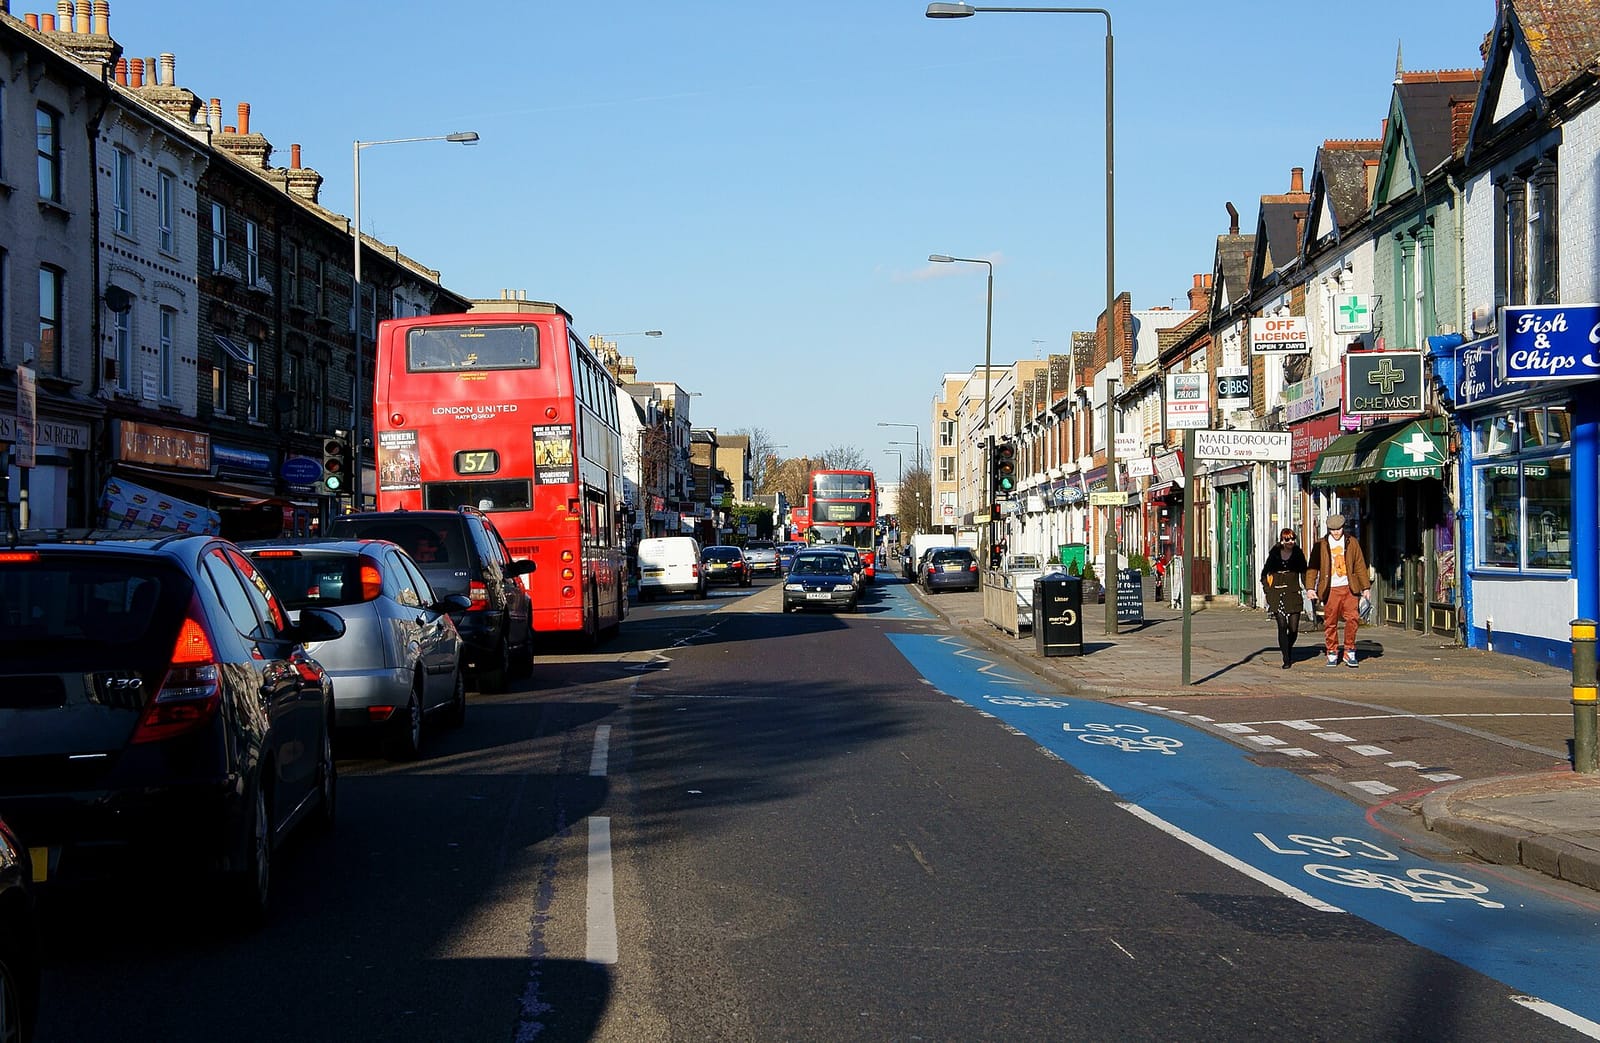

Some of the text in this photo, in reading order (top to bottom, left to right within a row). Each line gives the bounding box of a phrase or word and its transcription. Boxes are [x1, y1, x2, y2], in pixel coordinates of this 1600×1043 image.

[1265, 320, 1295, 331] OFF
[1516, 313, 1568, 334] Fish
[1254, 332, 1306, 341] LICENCE
[1534, 333, 1551, 349] &
[1463, 346, 1482, 367] Fish
[1510, 350, 1576, 375] Chips
[1470, 365, 1476, 378] &
[1175, 376, 1199, 384] CROSS
[1218, 380, 1248, 394] GIBBS
[1460, 379, 1486, 399] Chips
[1176, 390, 1199, 398] PRIOR
[1354, 395, 1418, 410] CHEMIST
[432, 404, 518, 415] LONDON UNITED
[44, 423, 79, 445] SURGERY
[380, 432, 414, 442] WINNER!
[1199, 434, 1287, 446] MARLBOROUGH
[1310, 435, 1323, 452] Have
[1198, 445, 1231, 456] ROAD
[464, 452, 489, 472] 57
[1386, 468, 1437, 478] CHEMIST
[1062, 722, 1150, 734] CS7
[1252, 832, 1400, 861] CS7
